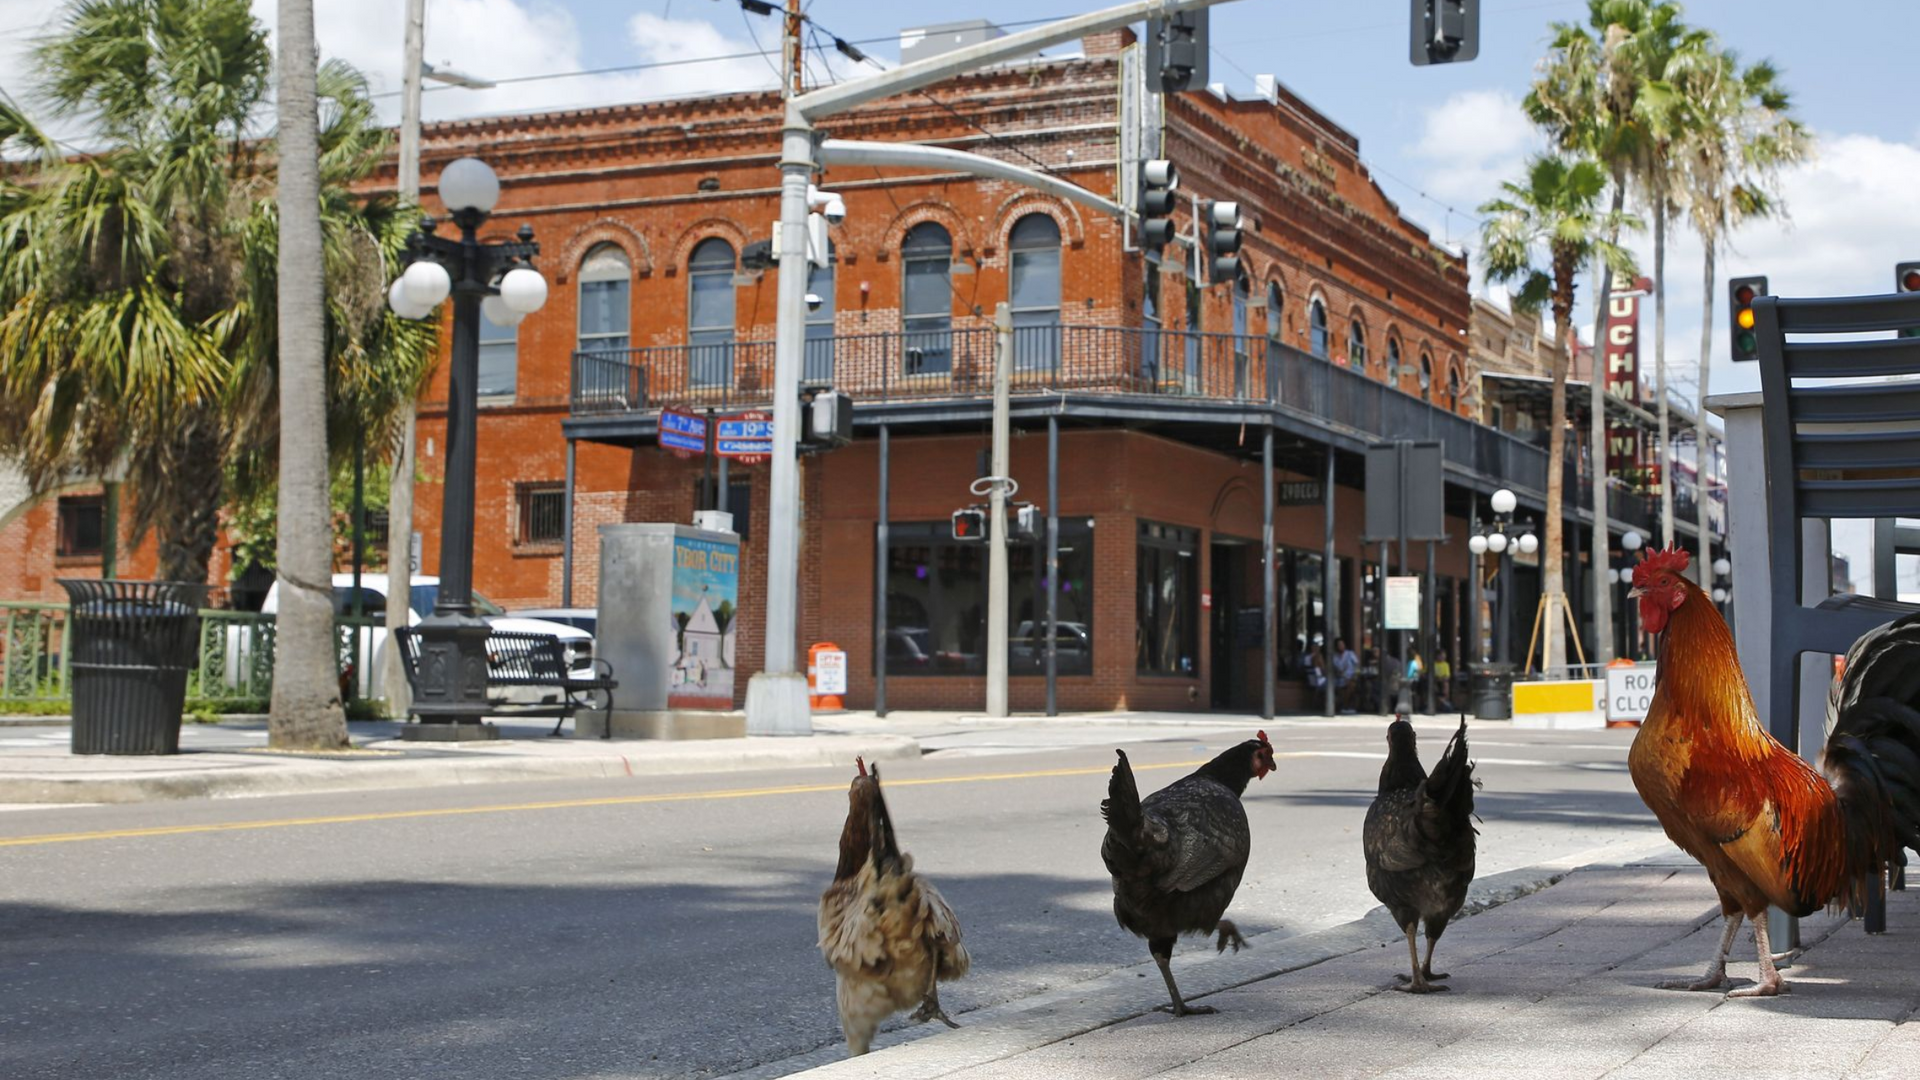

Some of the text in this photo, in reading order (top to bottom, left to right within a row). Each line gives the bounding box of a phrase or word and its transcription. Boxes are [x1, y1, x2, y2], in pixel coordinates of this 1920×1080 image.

[676, 546, 737, 573] YBOR CITY
[1625, 674, 1656, 690] RO
[1616, 695, 1650, 712] CLO
